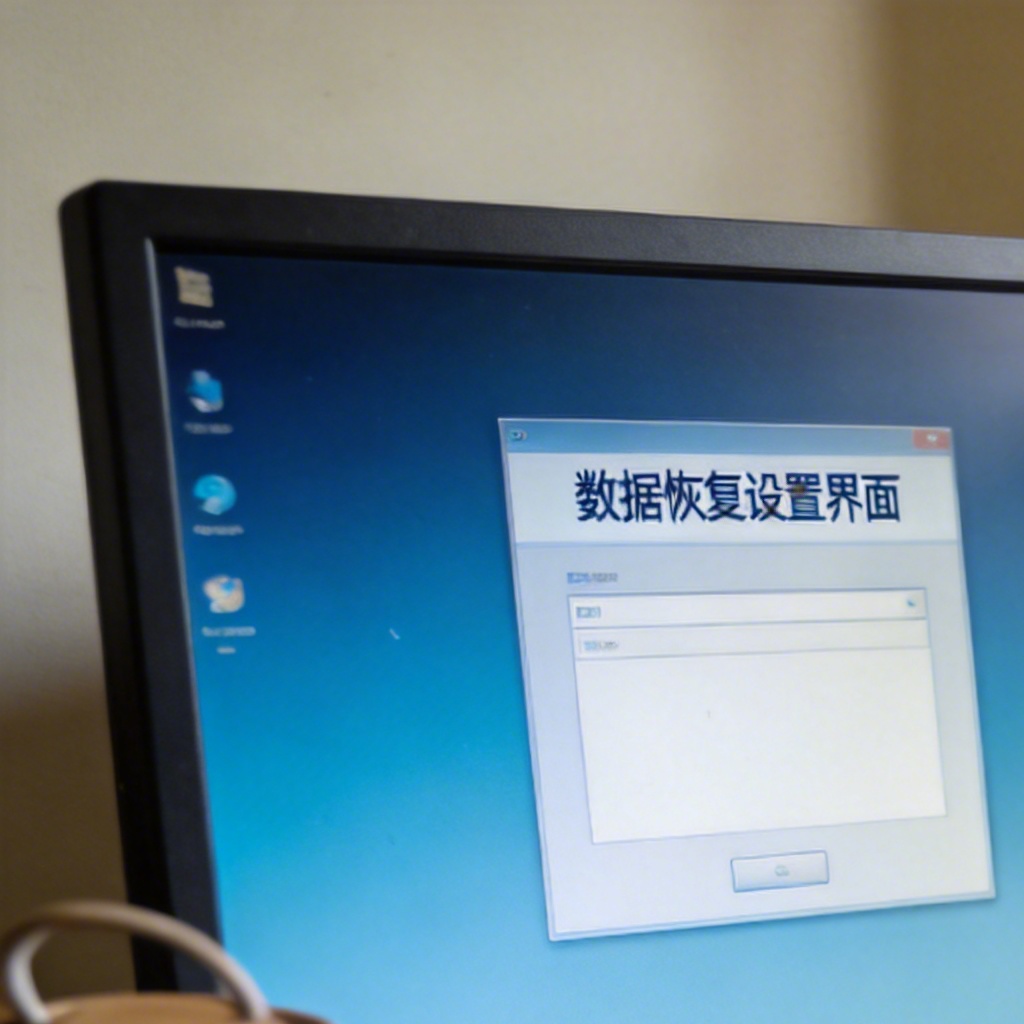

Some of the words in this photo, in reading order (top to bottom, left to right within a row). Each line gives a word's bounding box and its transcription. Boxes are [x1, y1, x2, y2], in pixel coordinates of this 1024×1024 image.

[575, 469, 901, 523] 数据恢复设置界面
